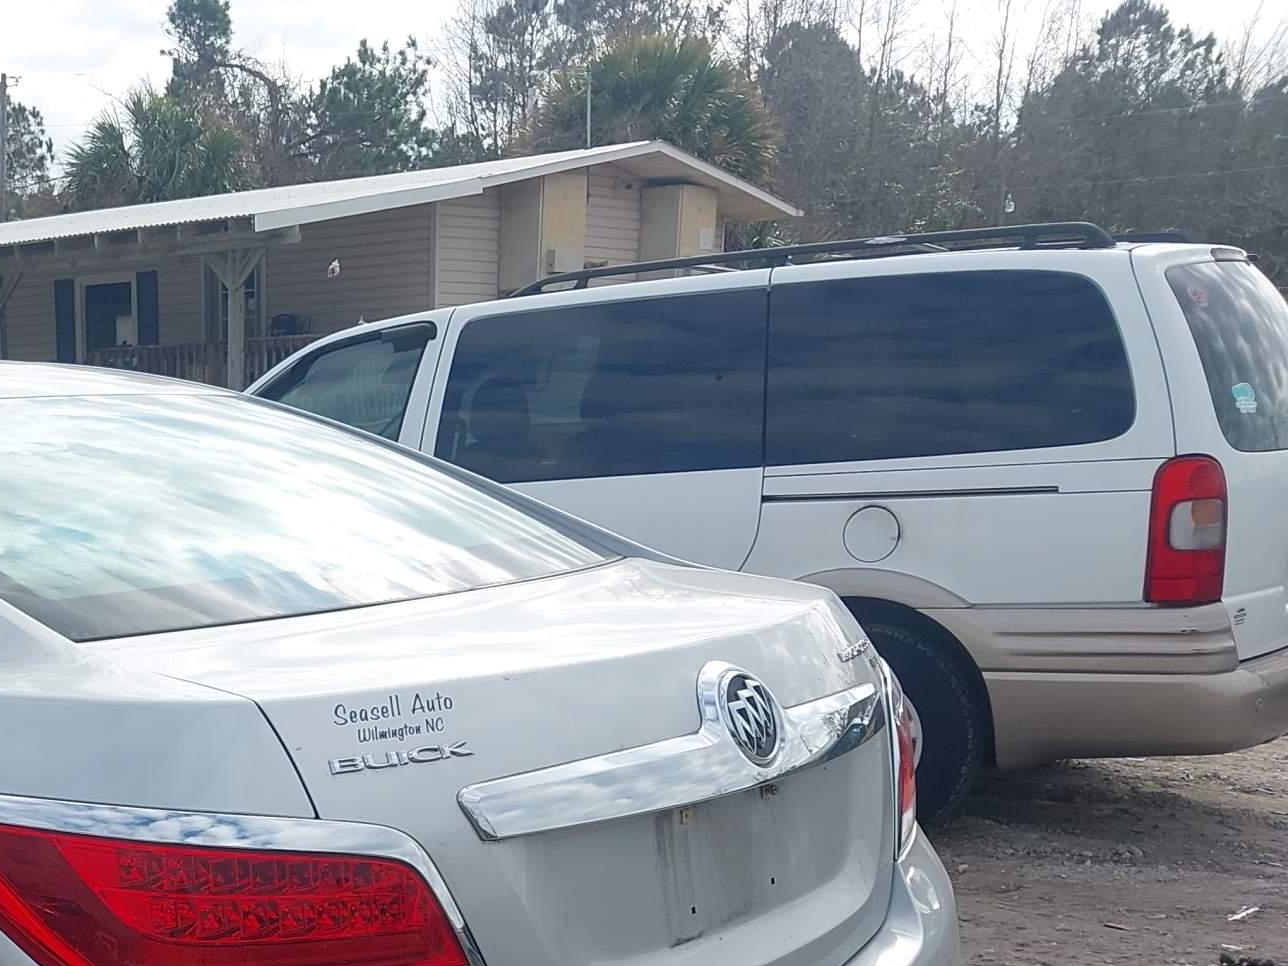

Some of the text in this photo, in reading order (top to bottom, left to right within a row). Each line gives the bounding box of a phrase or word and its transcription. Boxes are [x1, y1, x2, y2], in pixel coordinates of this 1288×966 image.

[334, 691, 453, 726] Seasell Auto
[358, 717, 444, 743] Wilmington NC
[328, 740, 474, 775] BUICK
